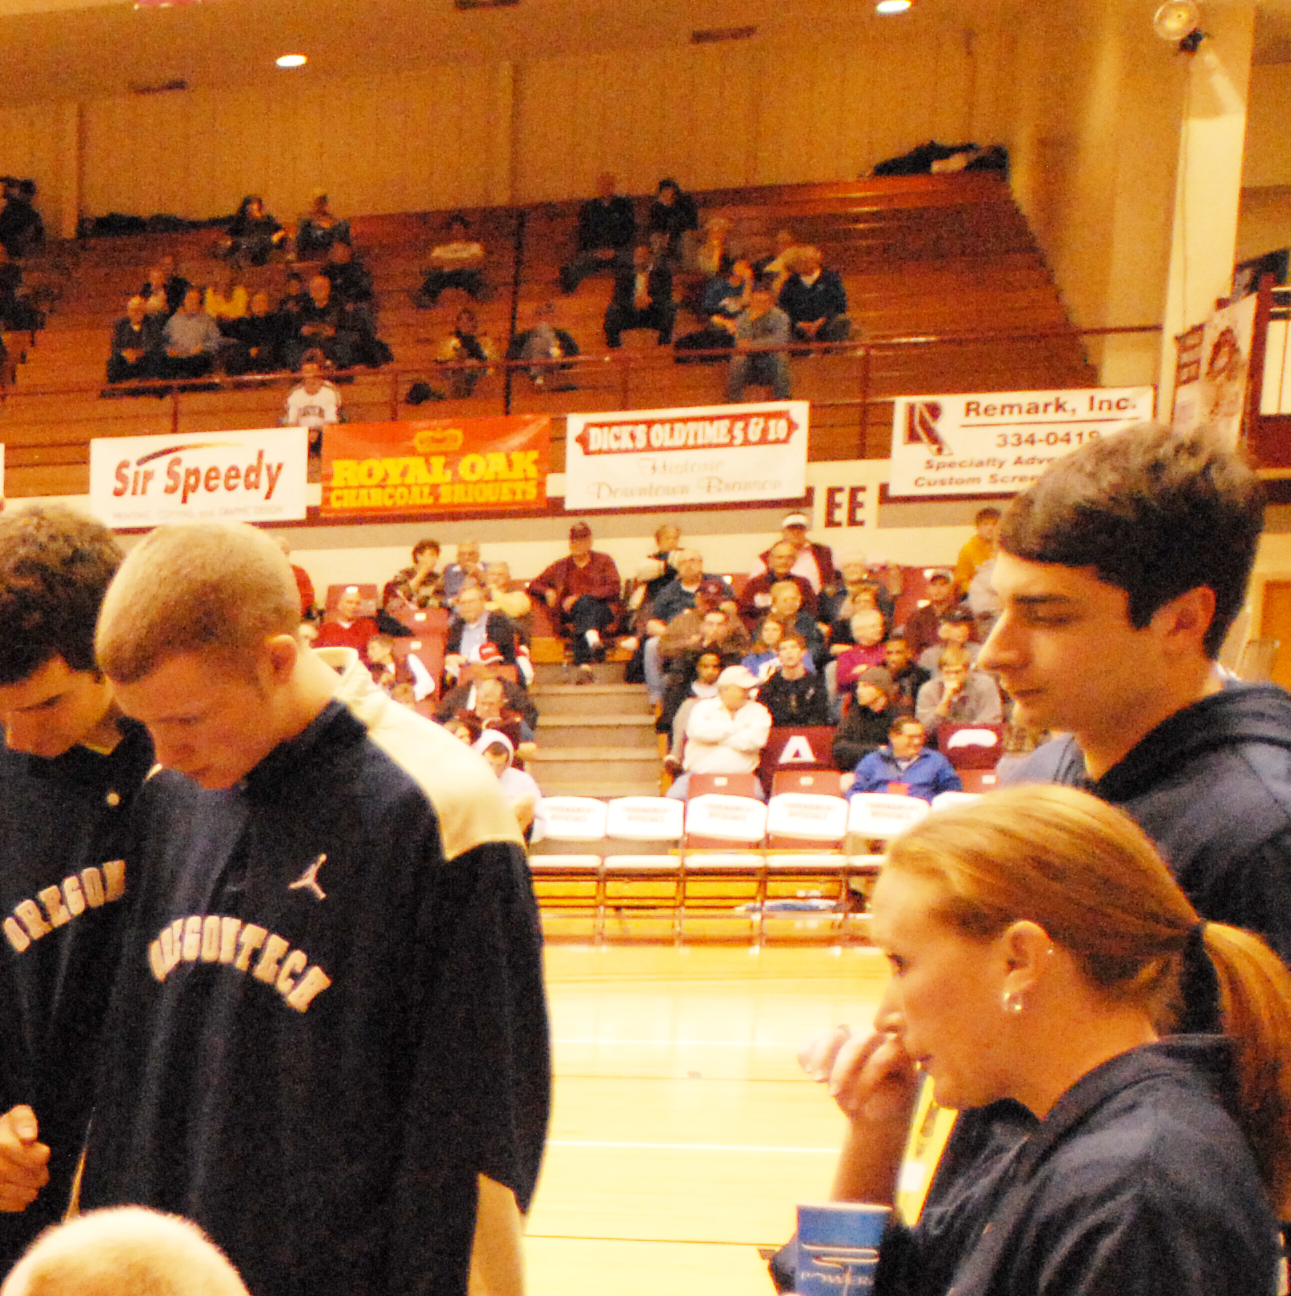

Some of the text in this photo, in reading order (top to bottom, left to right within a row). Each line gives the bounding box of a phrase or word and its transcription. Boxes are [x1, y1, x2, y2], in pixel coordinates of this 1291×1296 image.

[964, 394, 1138, 419] Remark, Inc.
[588, 417, 789, 451] DICK'S OLDTIME 5 & 10
[112, 449, 285, 504] Sir Speedy
[330, 450, 540, 488] ROYAL OAK
[914, 476, 985, 488] Custom
[329, 479, 538, 509] CHARCOAL BRIQUETS
[587, 481, 690, 500] Downtown
[824, 485, 869, 529] EE
[778, 735, 818, 764] A
[235, 922, 333, 1014] TECH
